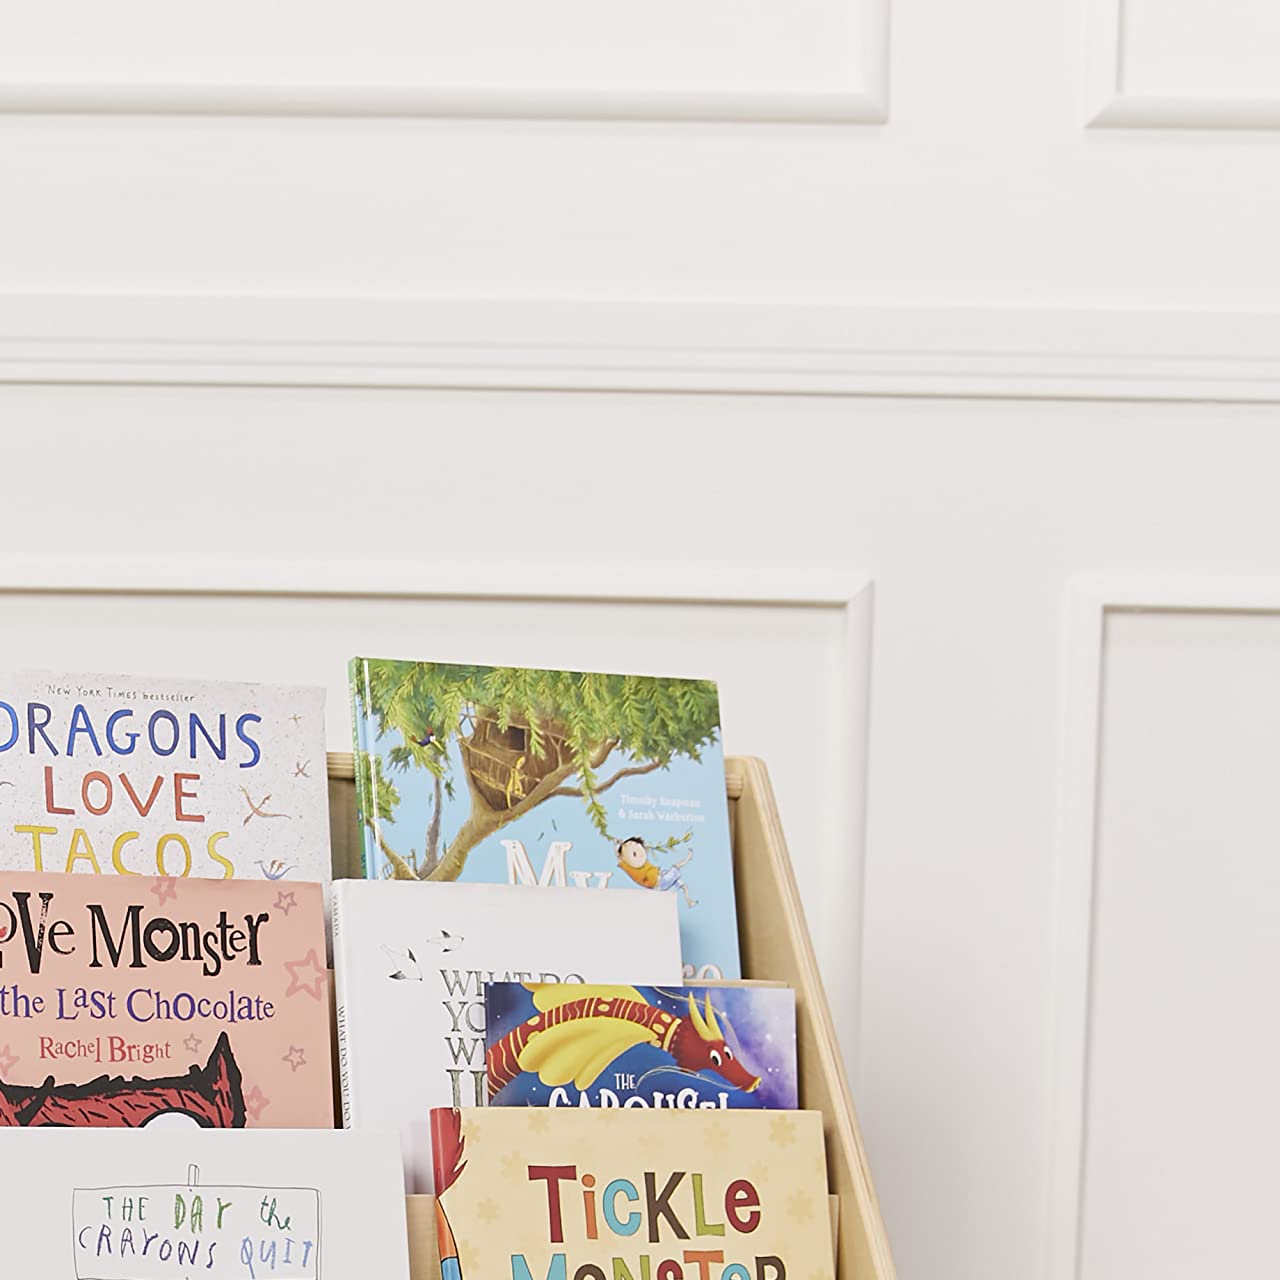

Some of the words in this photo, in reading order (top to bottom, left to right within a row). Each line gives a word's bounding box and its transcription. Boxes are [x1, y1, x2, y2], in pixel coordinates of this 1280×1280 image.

[143, 692, 195, 702] bestseller
[44, 766, 205, 823] LOVE
[14, 825, 235, 879] TACOS
[86, 904, 269, 977] Monster
[0, 984, 46, 1018] the
[56, 986, 118, 1021] Last
[126, 988, 276, 1024] Chocolate
[39, 1036, 101, 1063] Rachel
[108, 1036, 172, 1065] Bright
[614, 1073, 636, 1090] THE
[102, 1197, 148, 1221] THE
[174, 1193, 232, 1234] DAY
[260, 1195, 291, 1231] the
[78, 1223, 217, 1269] CRAYONS
[240, 1236, 312, 1280] QUIT
